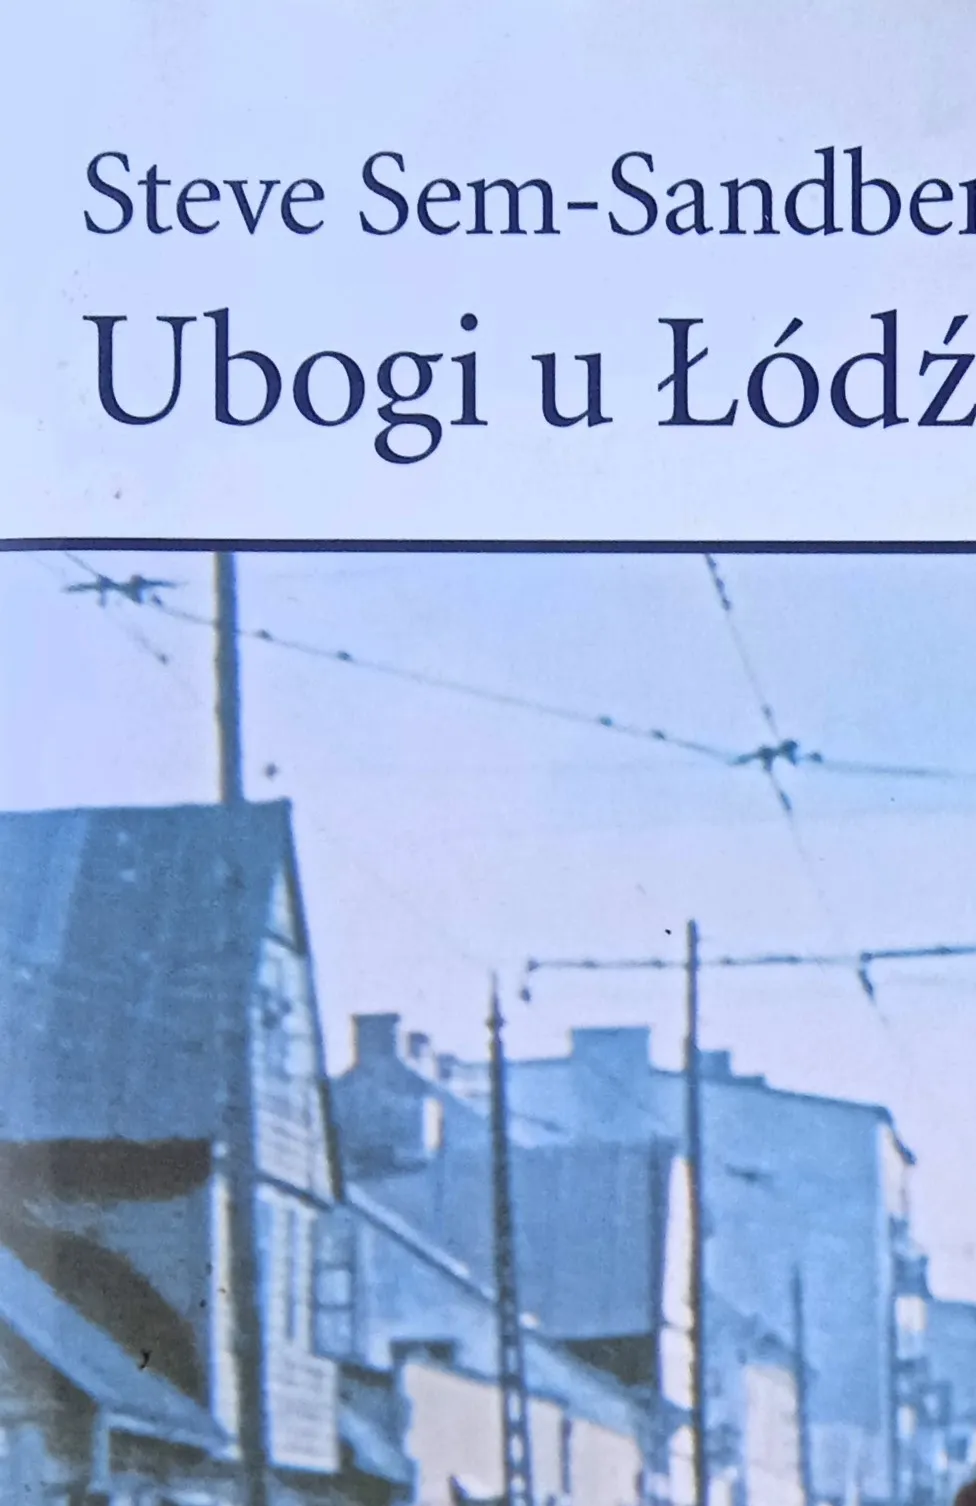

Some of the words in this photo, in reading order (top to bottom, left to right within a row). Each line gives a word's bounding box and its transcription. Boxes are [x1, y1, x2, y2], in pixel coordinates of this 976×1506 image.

[83, 150, 325, 236] Steve
[82, 307, 489, 465] Ubogi
[531, 352, 614, 428] u
